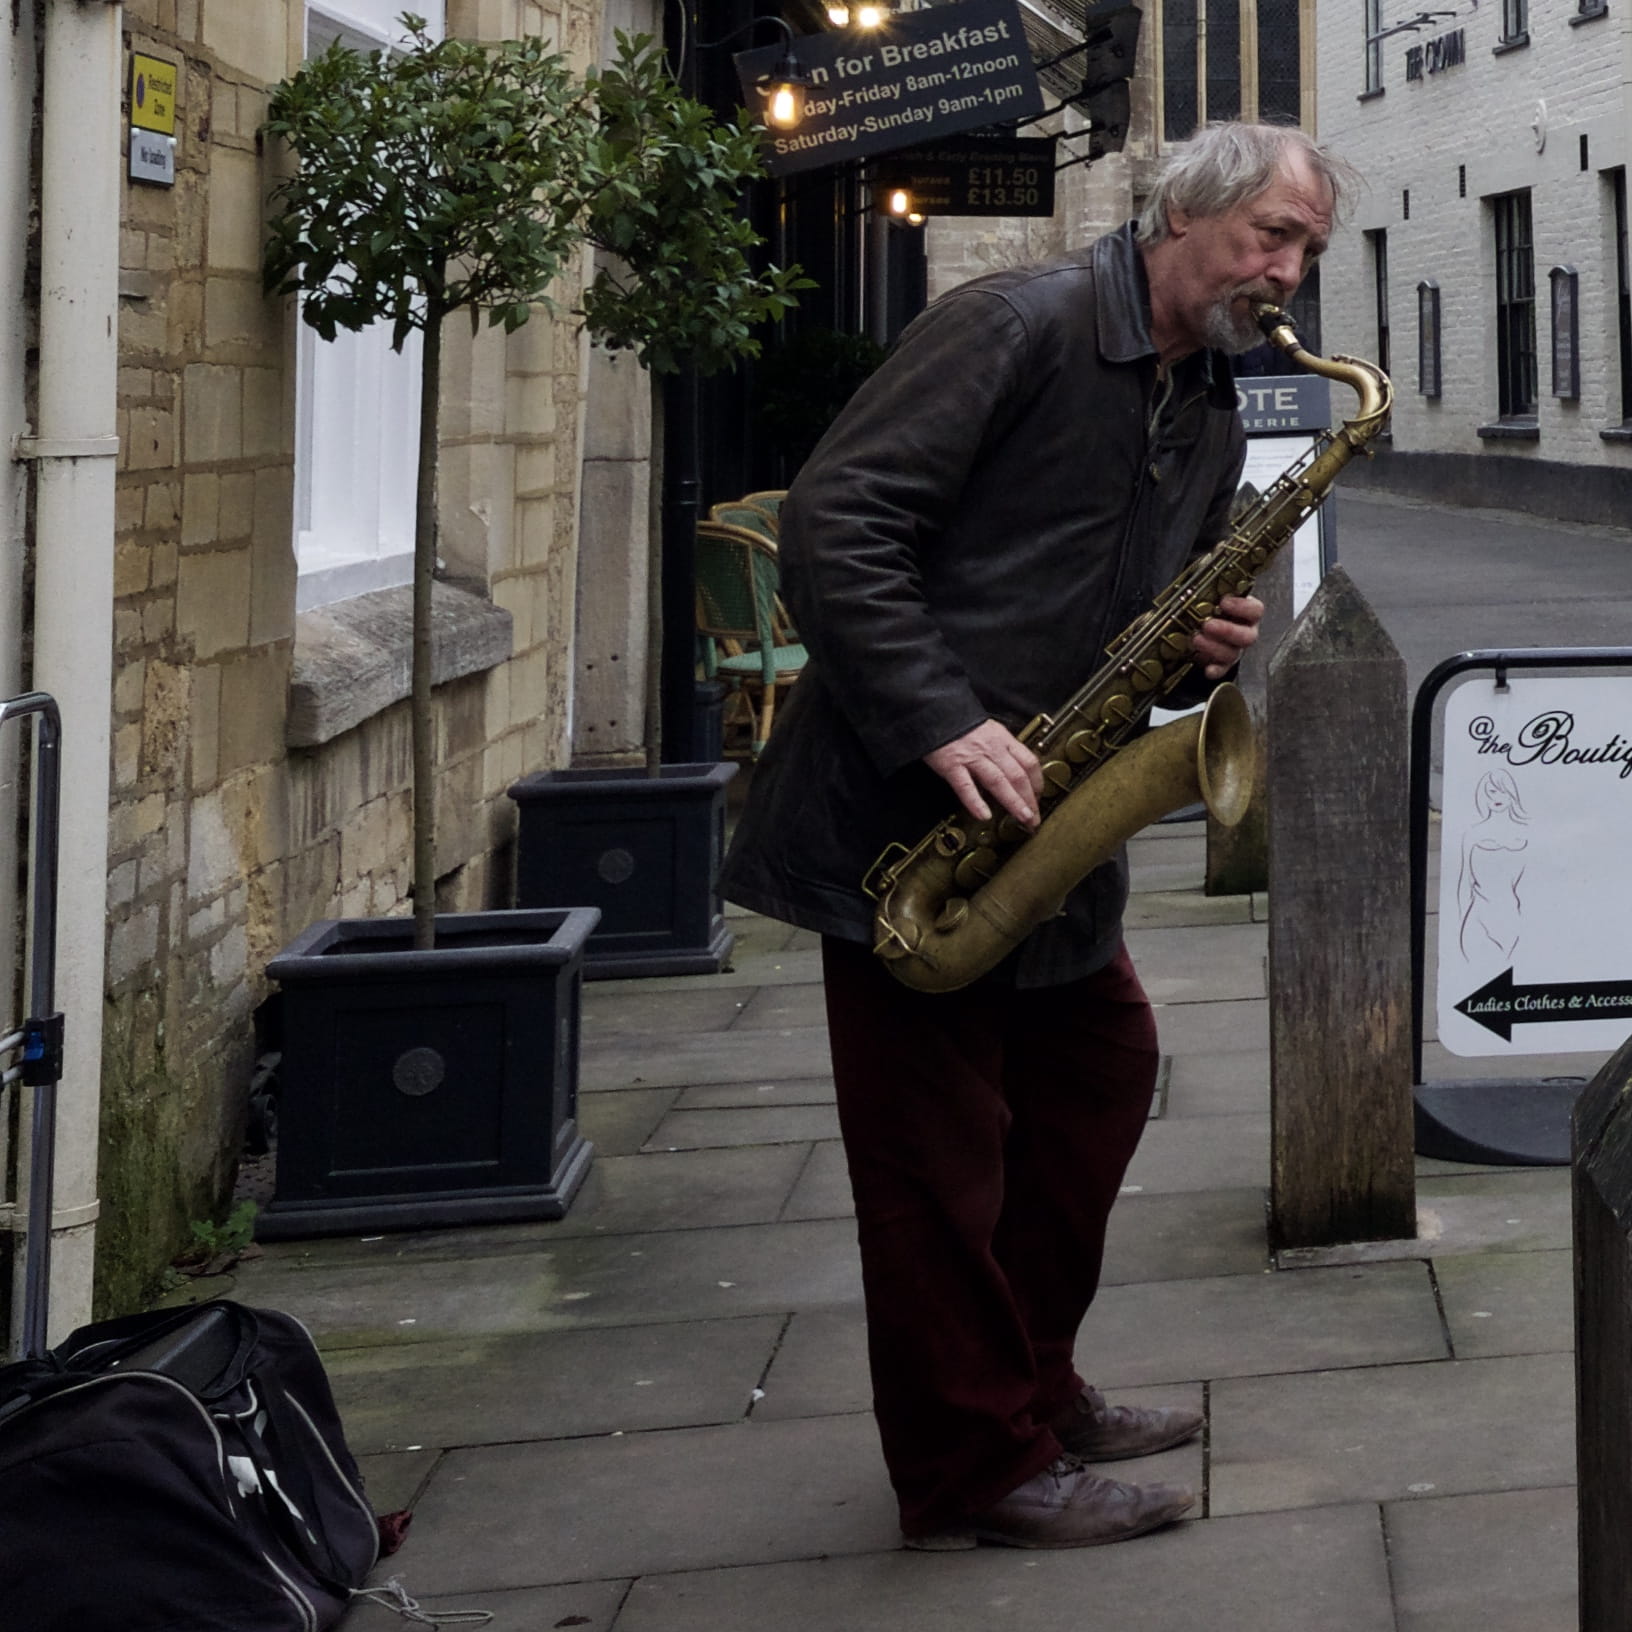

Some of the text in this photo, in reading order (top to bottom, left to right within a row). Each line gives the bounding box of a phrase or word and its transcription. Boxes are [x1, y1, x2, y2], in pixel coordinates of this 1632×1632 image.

[835, 55, 873, 79] for
[880, 19, 1010, 68] Breakfast
[906, 53, 1019, 92] 8am-12noon
[775, 83, 1023, 156] Saturday-Sunday 9am-1pm
[967, 168, 1038, 186] £11.50
[967, 188, 1039, 206] £13.50
[1477, 734, 1512, 754] the
[1467, 995, 1512, 1014] Ladies
[1514, 993, 1566, 1012] Clothes
[1567, 996, 1585, 1009] &
